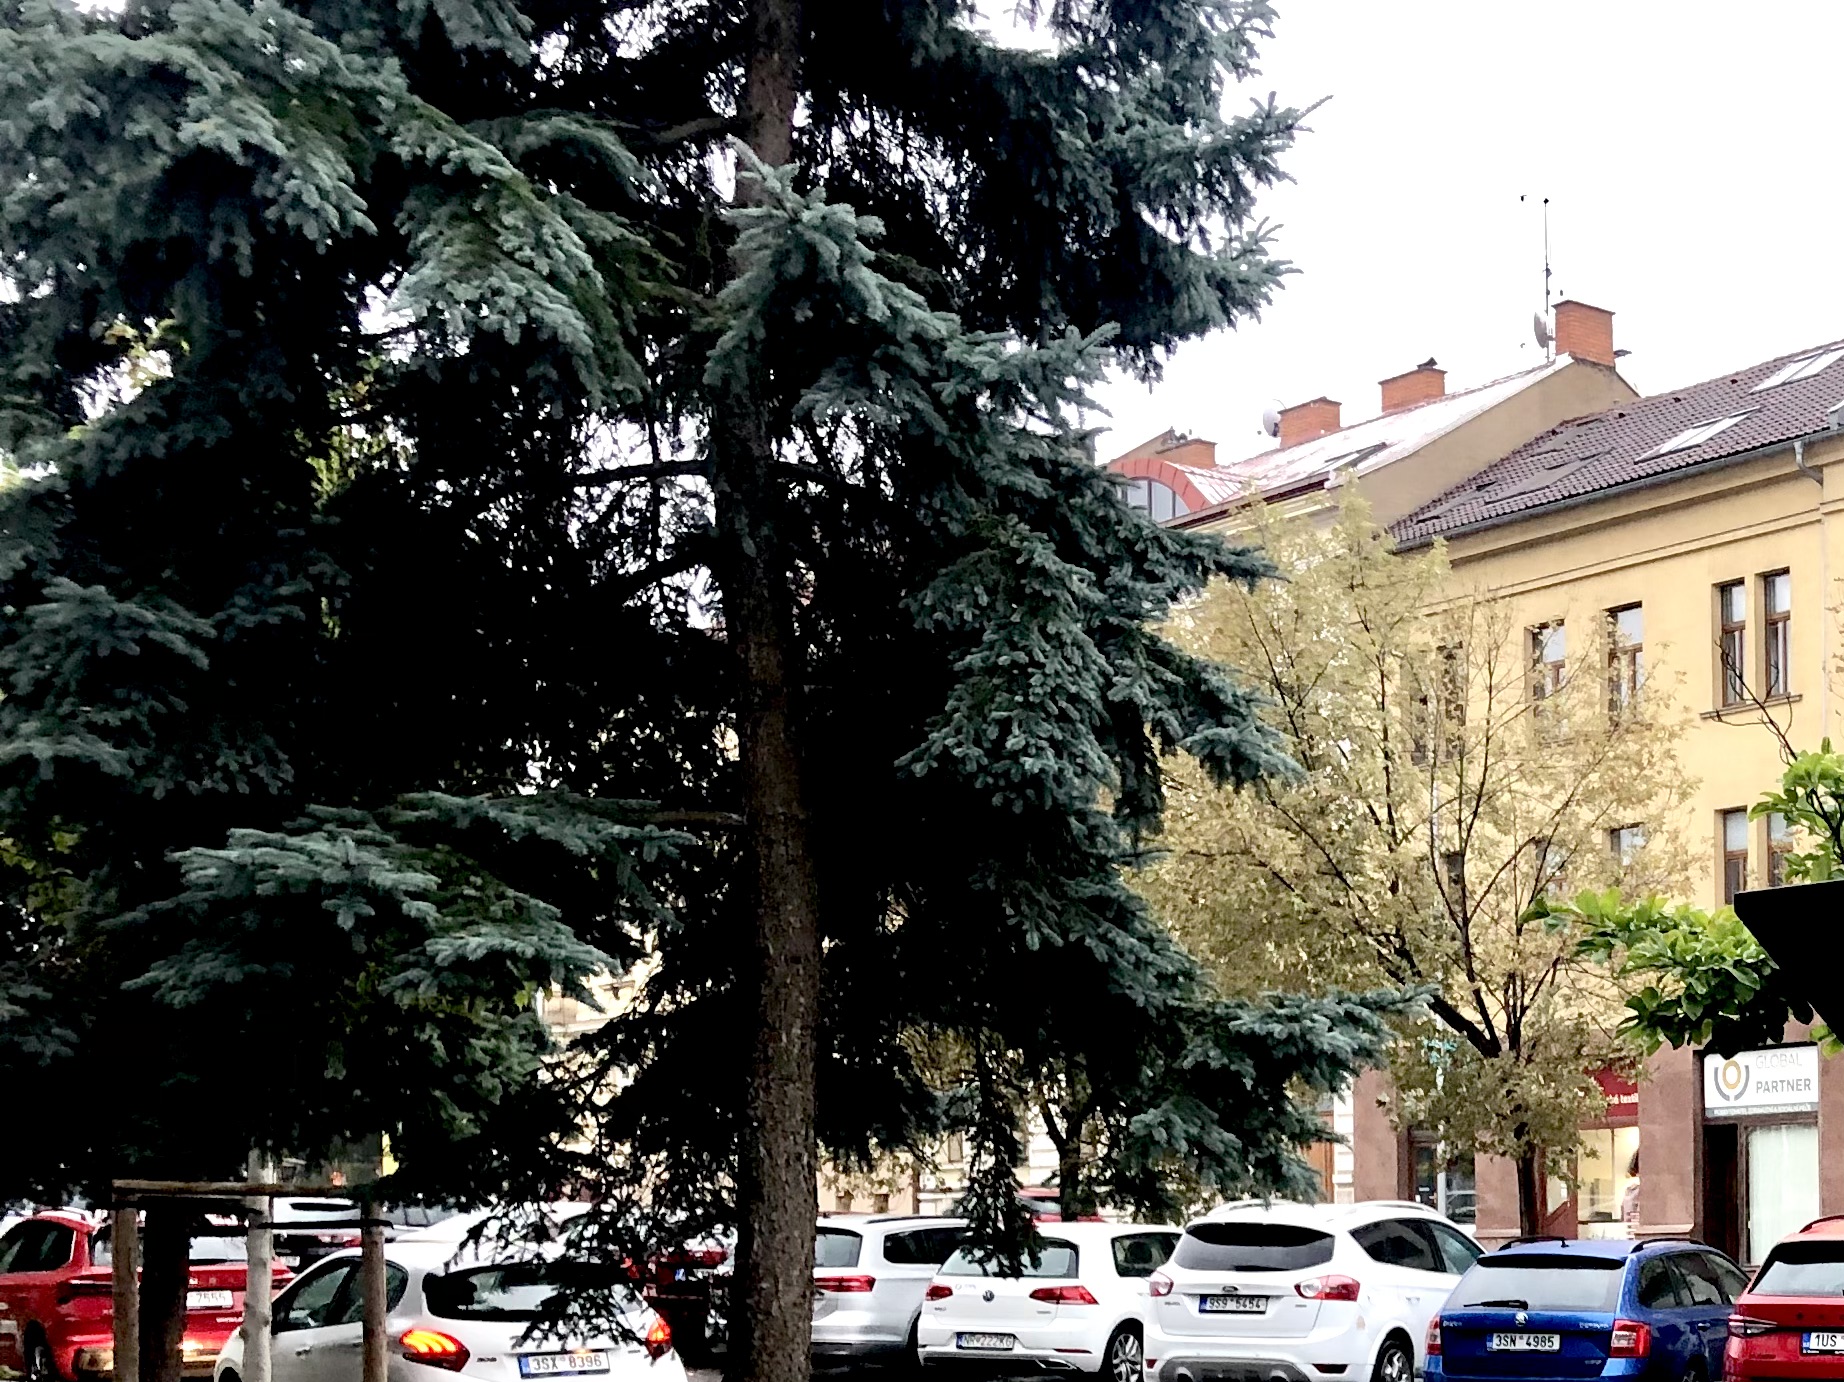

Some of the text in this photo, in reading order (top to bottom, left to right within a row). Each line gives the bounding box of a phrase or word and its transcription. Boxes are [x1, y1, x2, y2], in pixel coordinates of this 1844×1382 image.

[1755, 1052, 1803, 1069] GLOBAL
[1755, 1077, 1812, 1095] PARTNER
[1495, 1334, 1555, 1348] 3SN 4985
[1814, 1333, 1838, 1348] 1US
